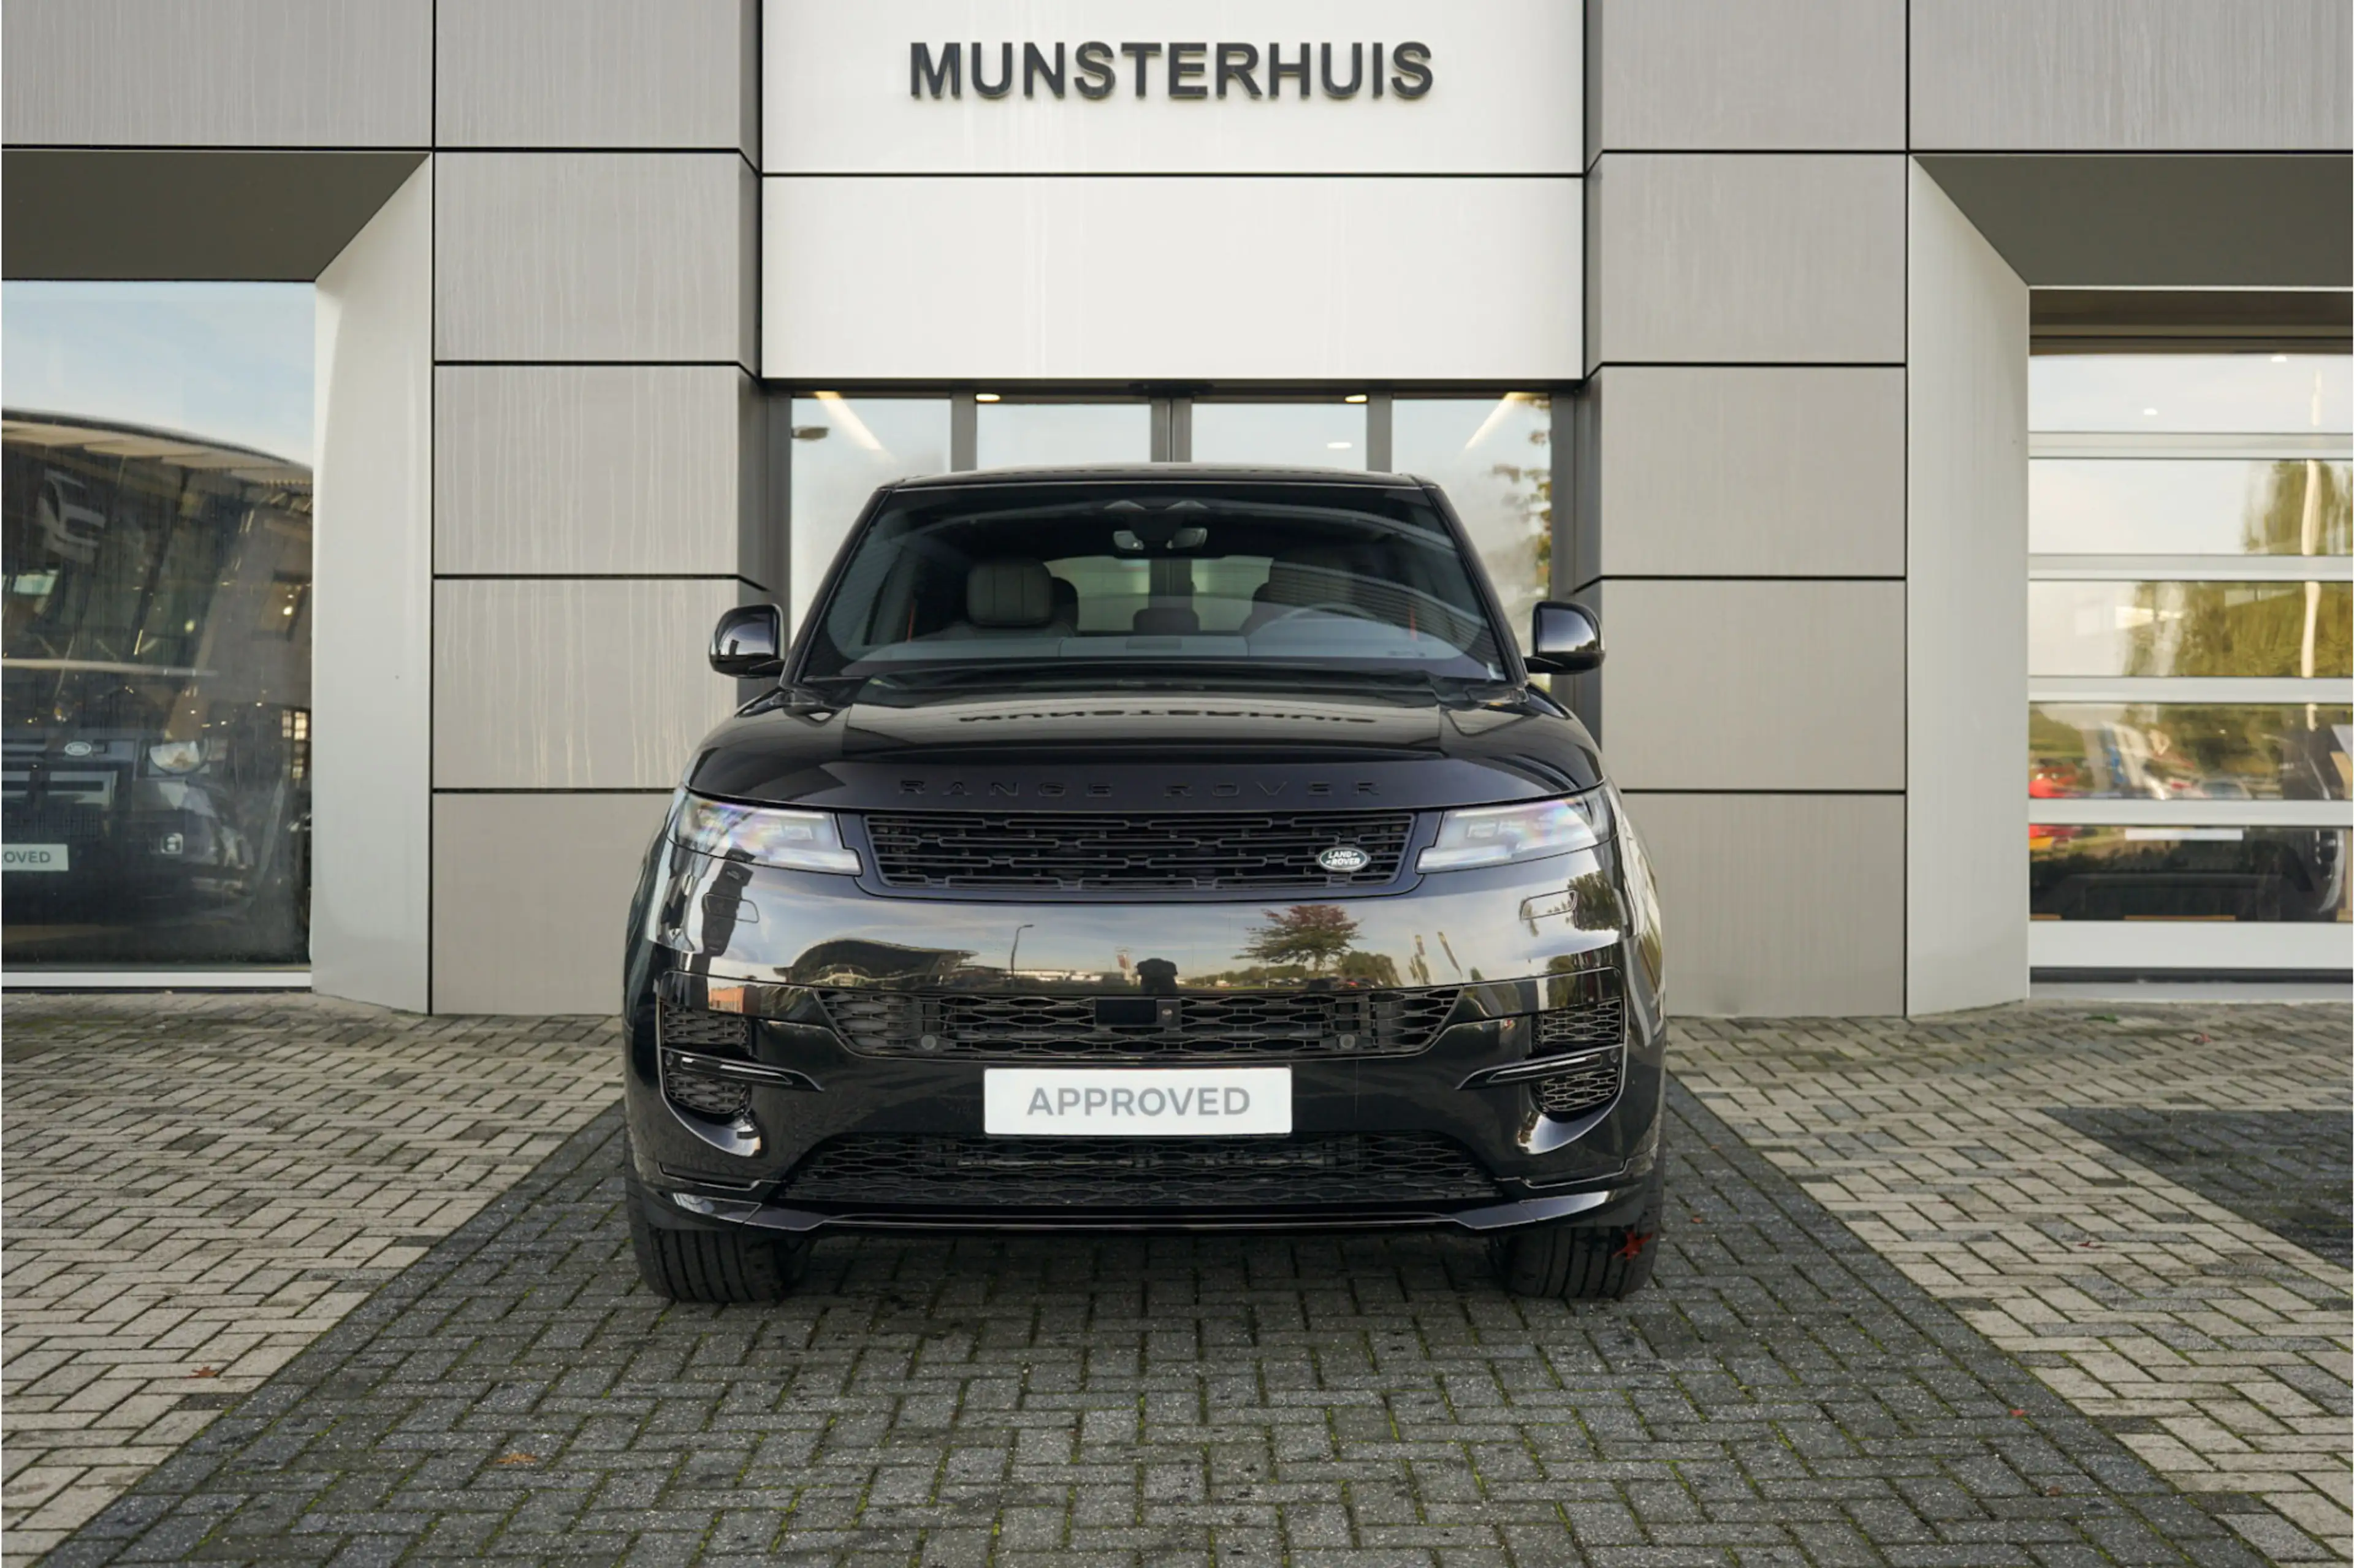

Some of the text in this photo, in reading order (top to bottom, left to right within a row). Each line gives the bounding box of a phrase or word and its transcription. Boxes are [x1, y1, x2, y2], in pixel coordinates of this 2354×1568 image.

[910, 42, 1434, 99] MUNSTERHUIS
[899, 780, 1380, 797] RANGE ROVER
[2, 850, 51, 864] OVED
[1331, 858, 1360, 866] ROVER
[1027, 1087, 1251, 1116] APPROVED
